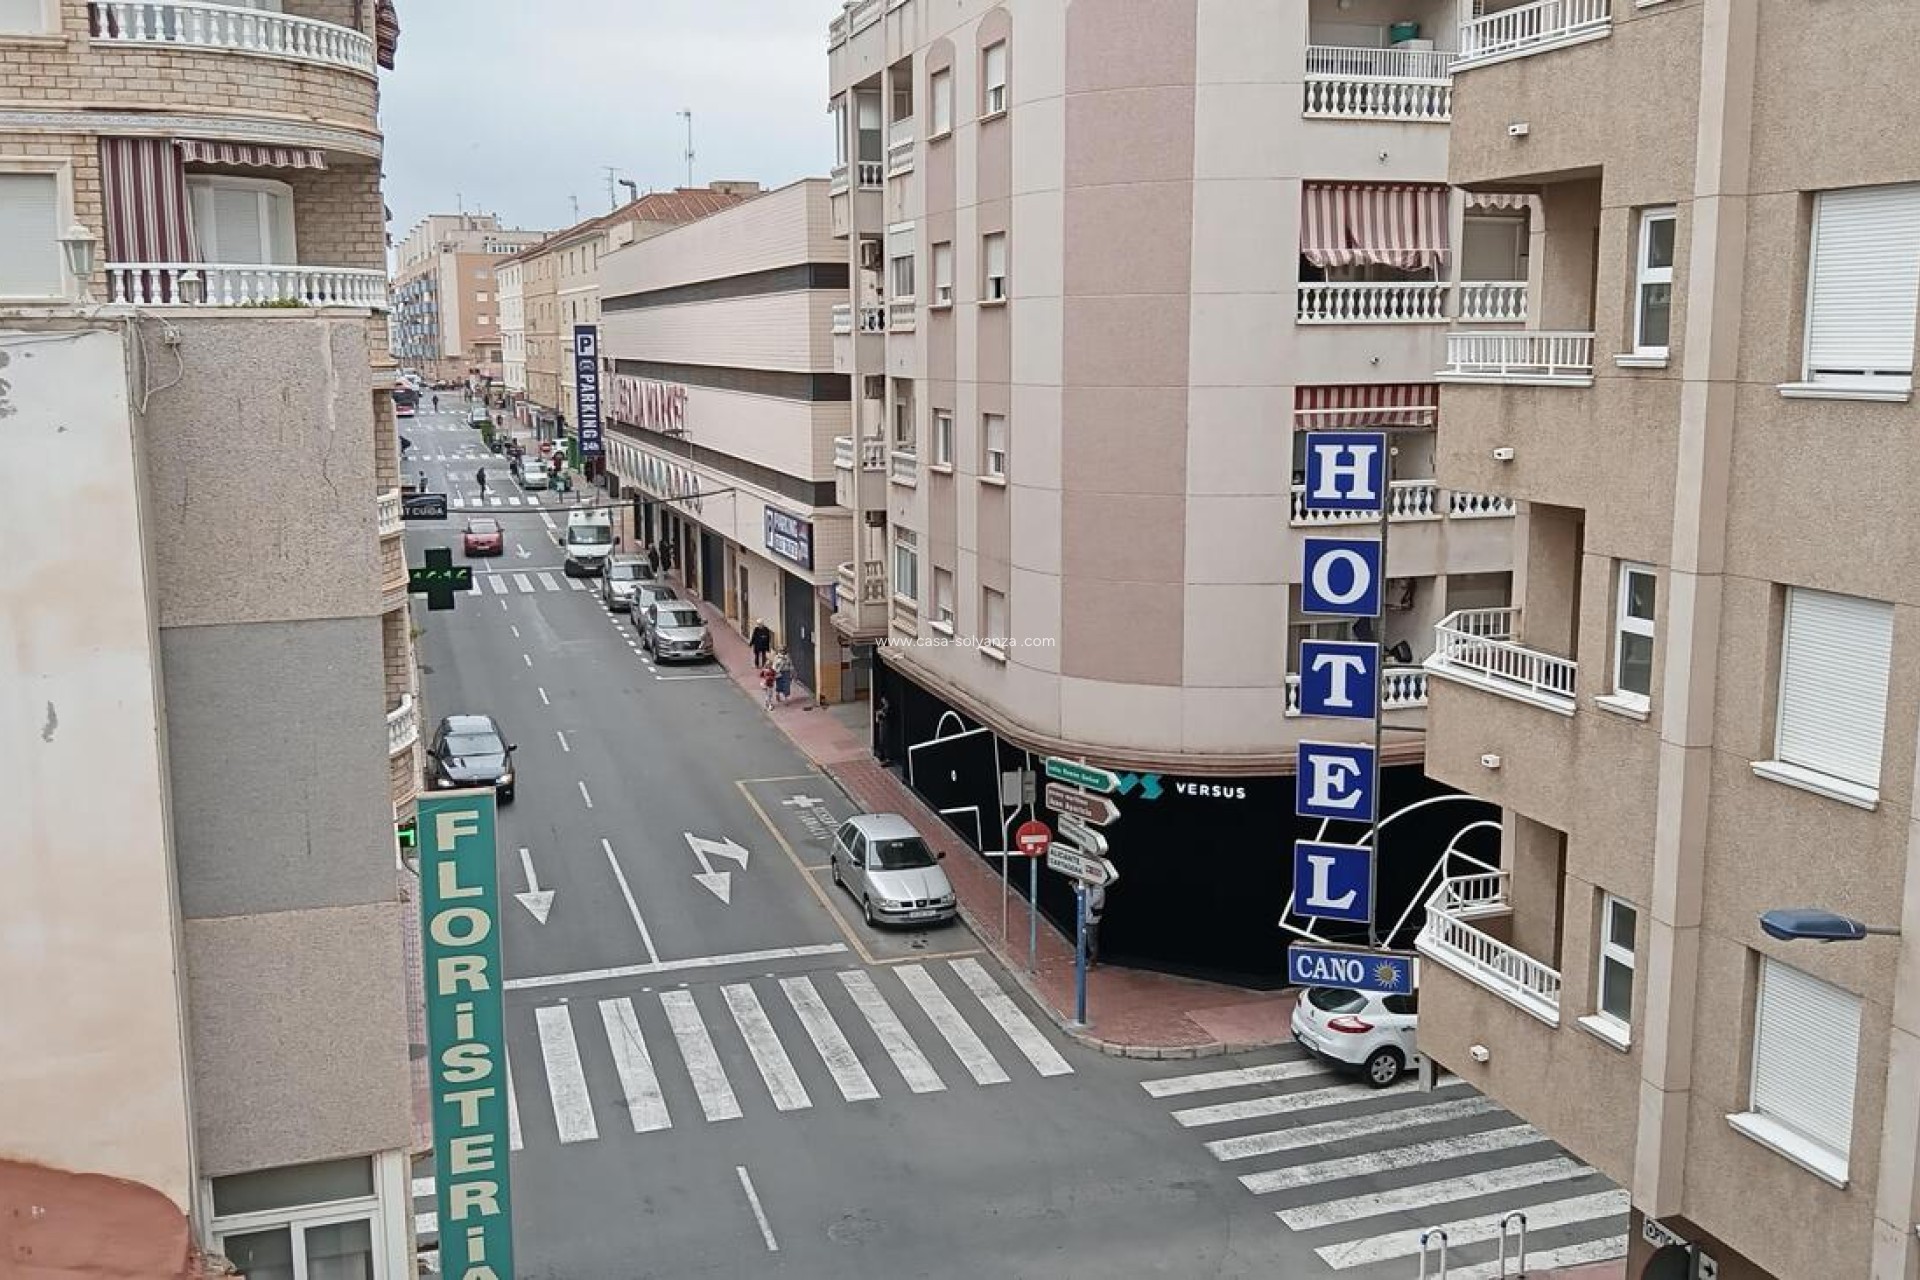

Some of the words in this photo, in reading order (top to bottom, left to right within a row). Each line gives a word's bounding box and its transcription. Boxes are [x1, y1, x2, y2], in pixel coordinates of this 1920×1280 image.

[580, 337, 592, 353] P
[580, 374, 598, 438] PARKING
[1306, 444, 1378, 909] HOTEL
[1175, 782, 1246, 799] VERSUS
[1297, 955, 1365, 982] CANO
